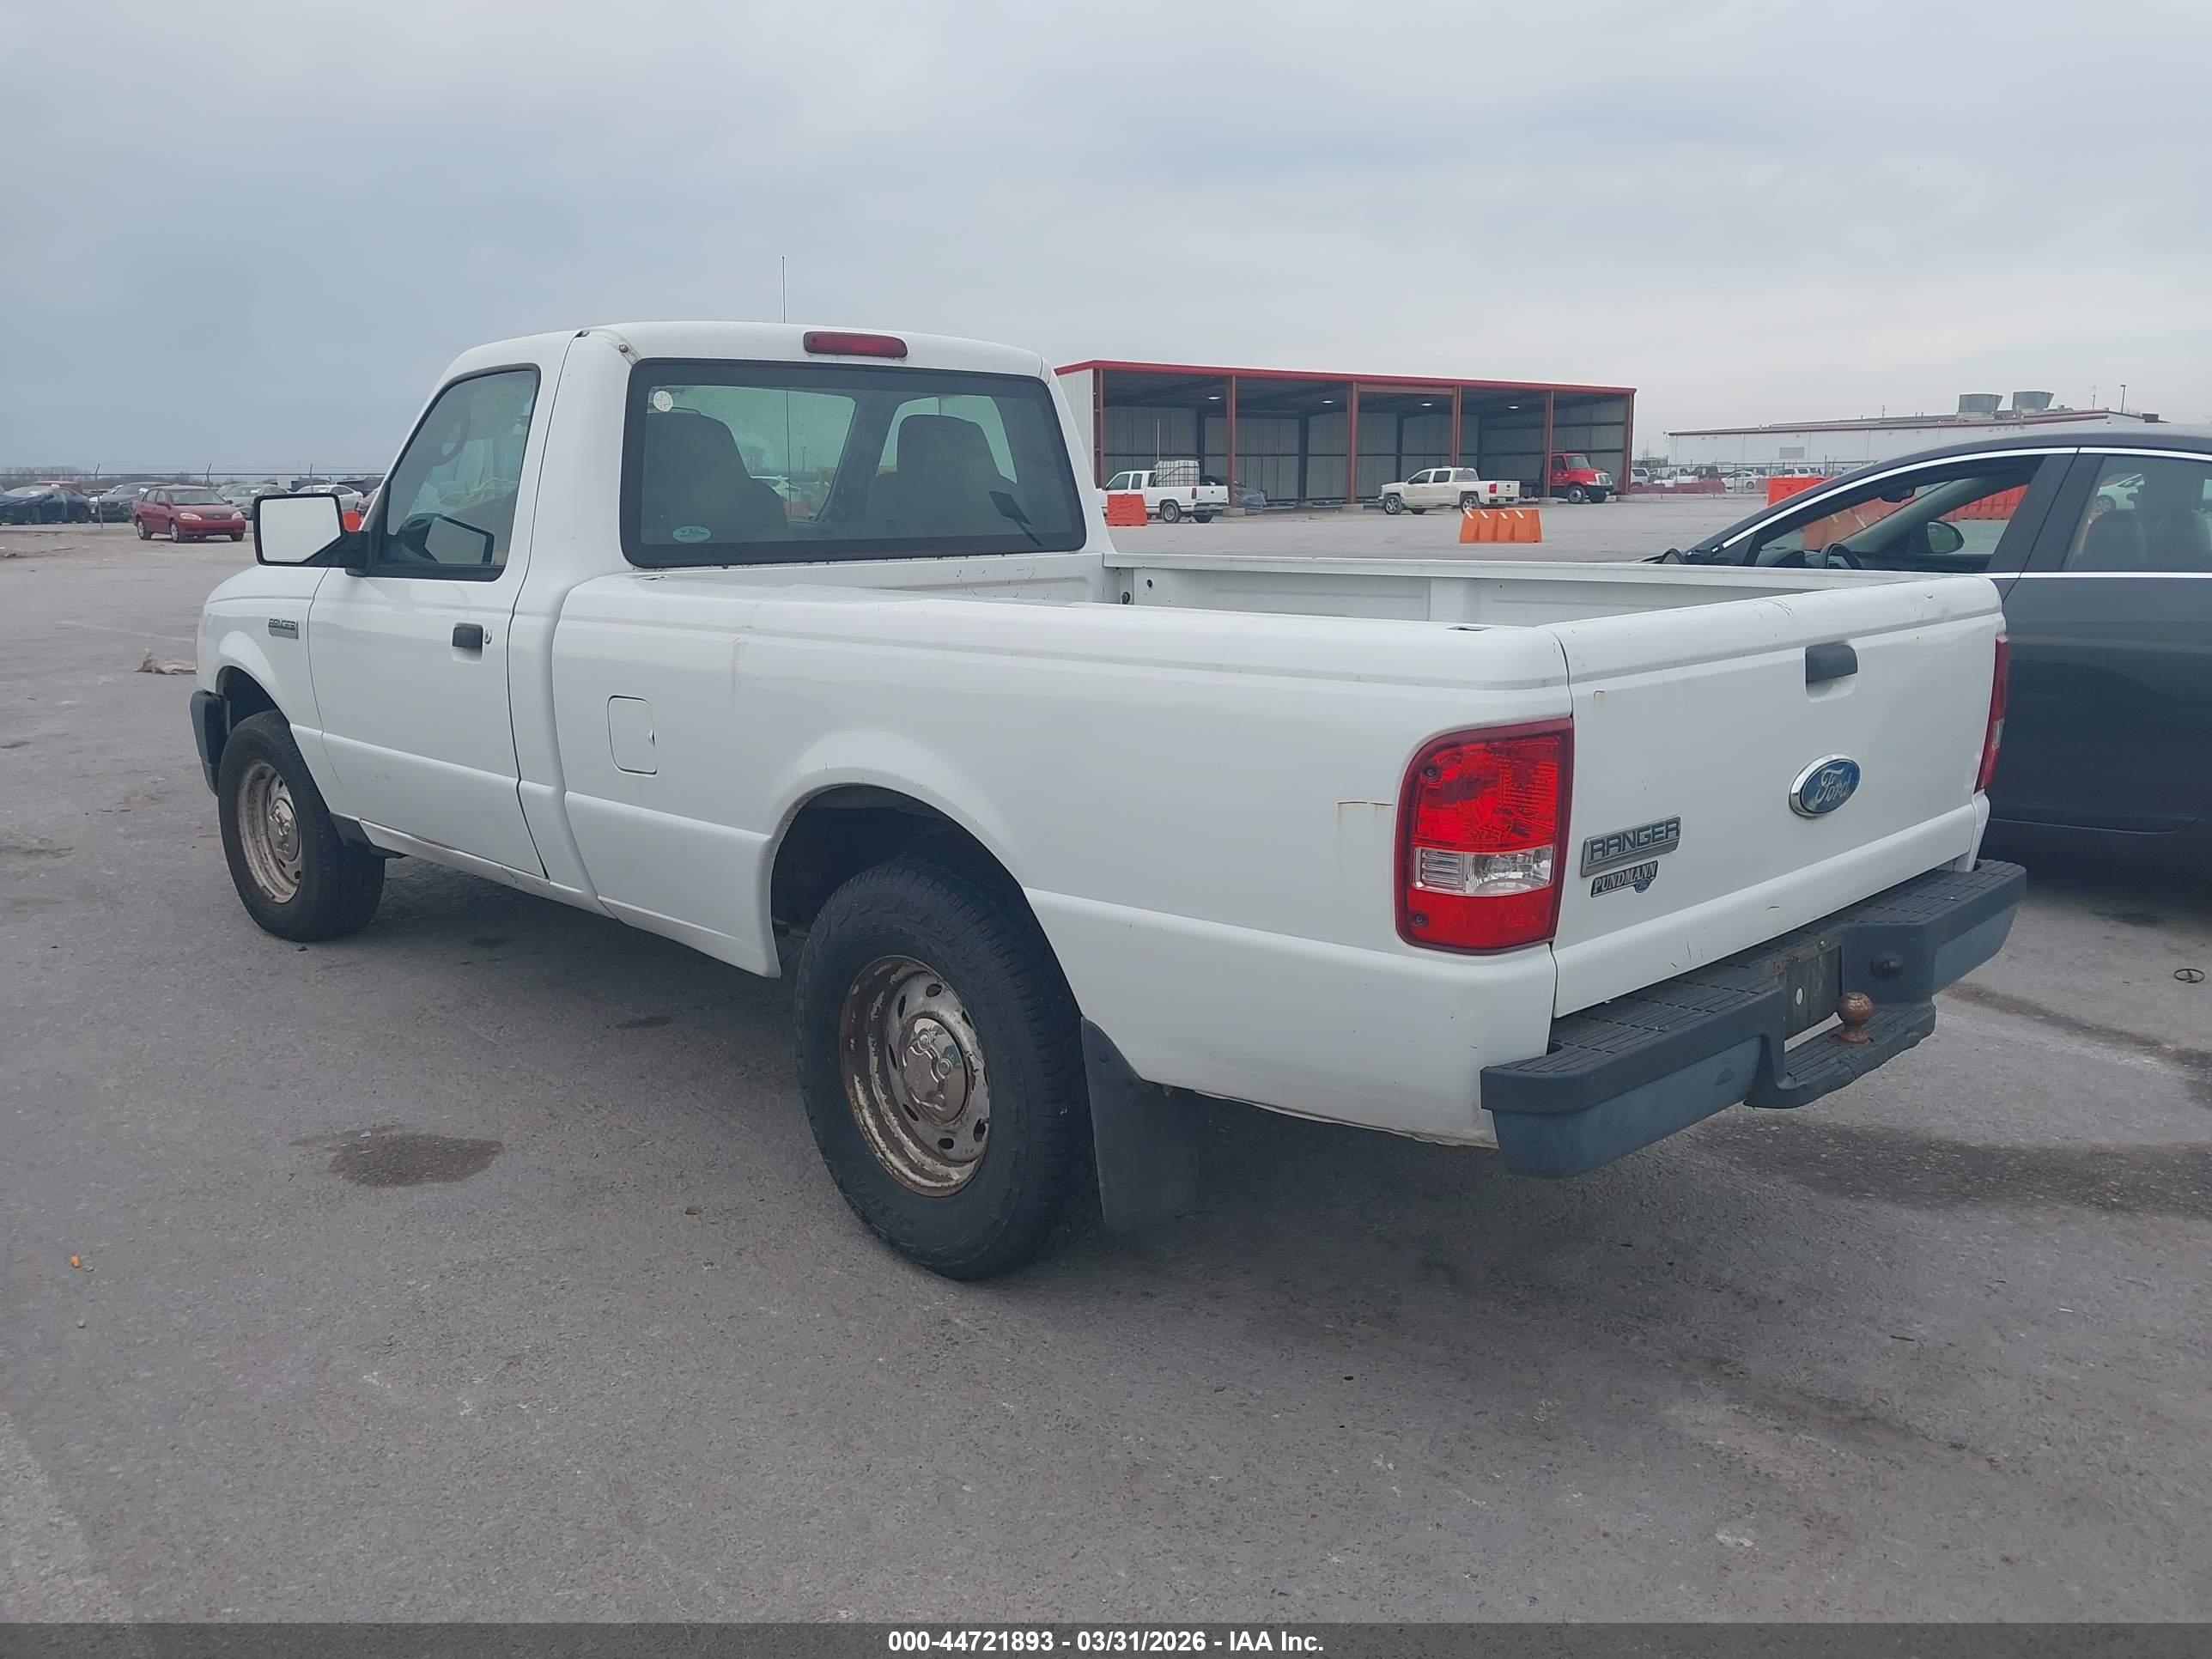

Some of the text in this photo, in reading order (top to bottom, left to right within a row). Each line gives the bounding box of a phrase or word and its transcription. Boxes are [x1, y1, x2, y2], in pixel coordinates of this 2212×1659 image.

[1814, 767, 1853, 804] Ford
[1589, 819, 1679, 861] RANGER
[1593, 861, 1656, 894] PUNDMANN
